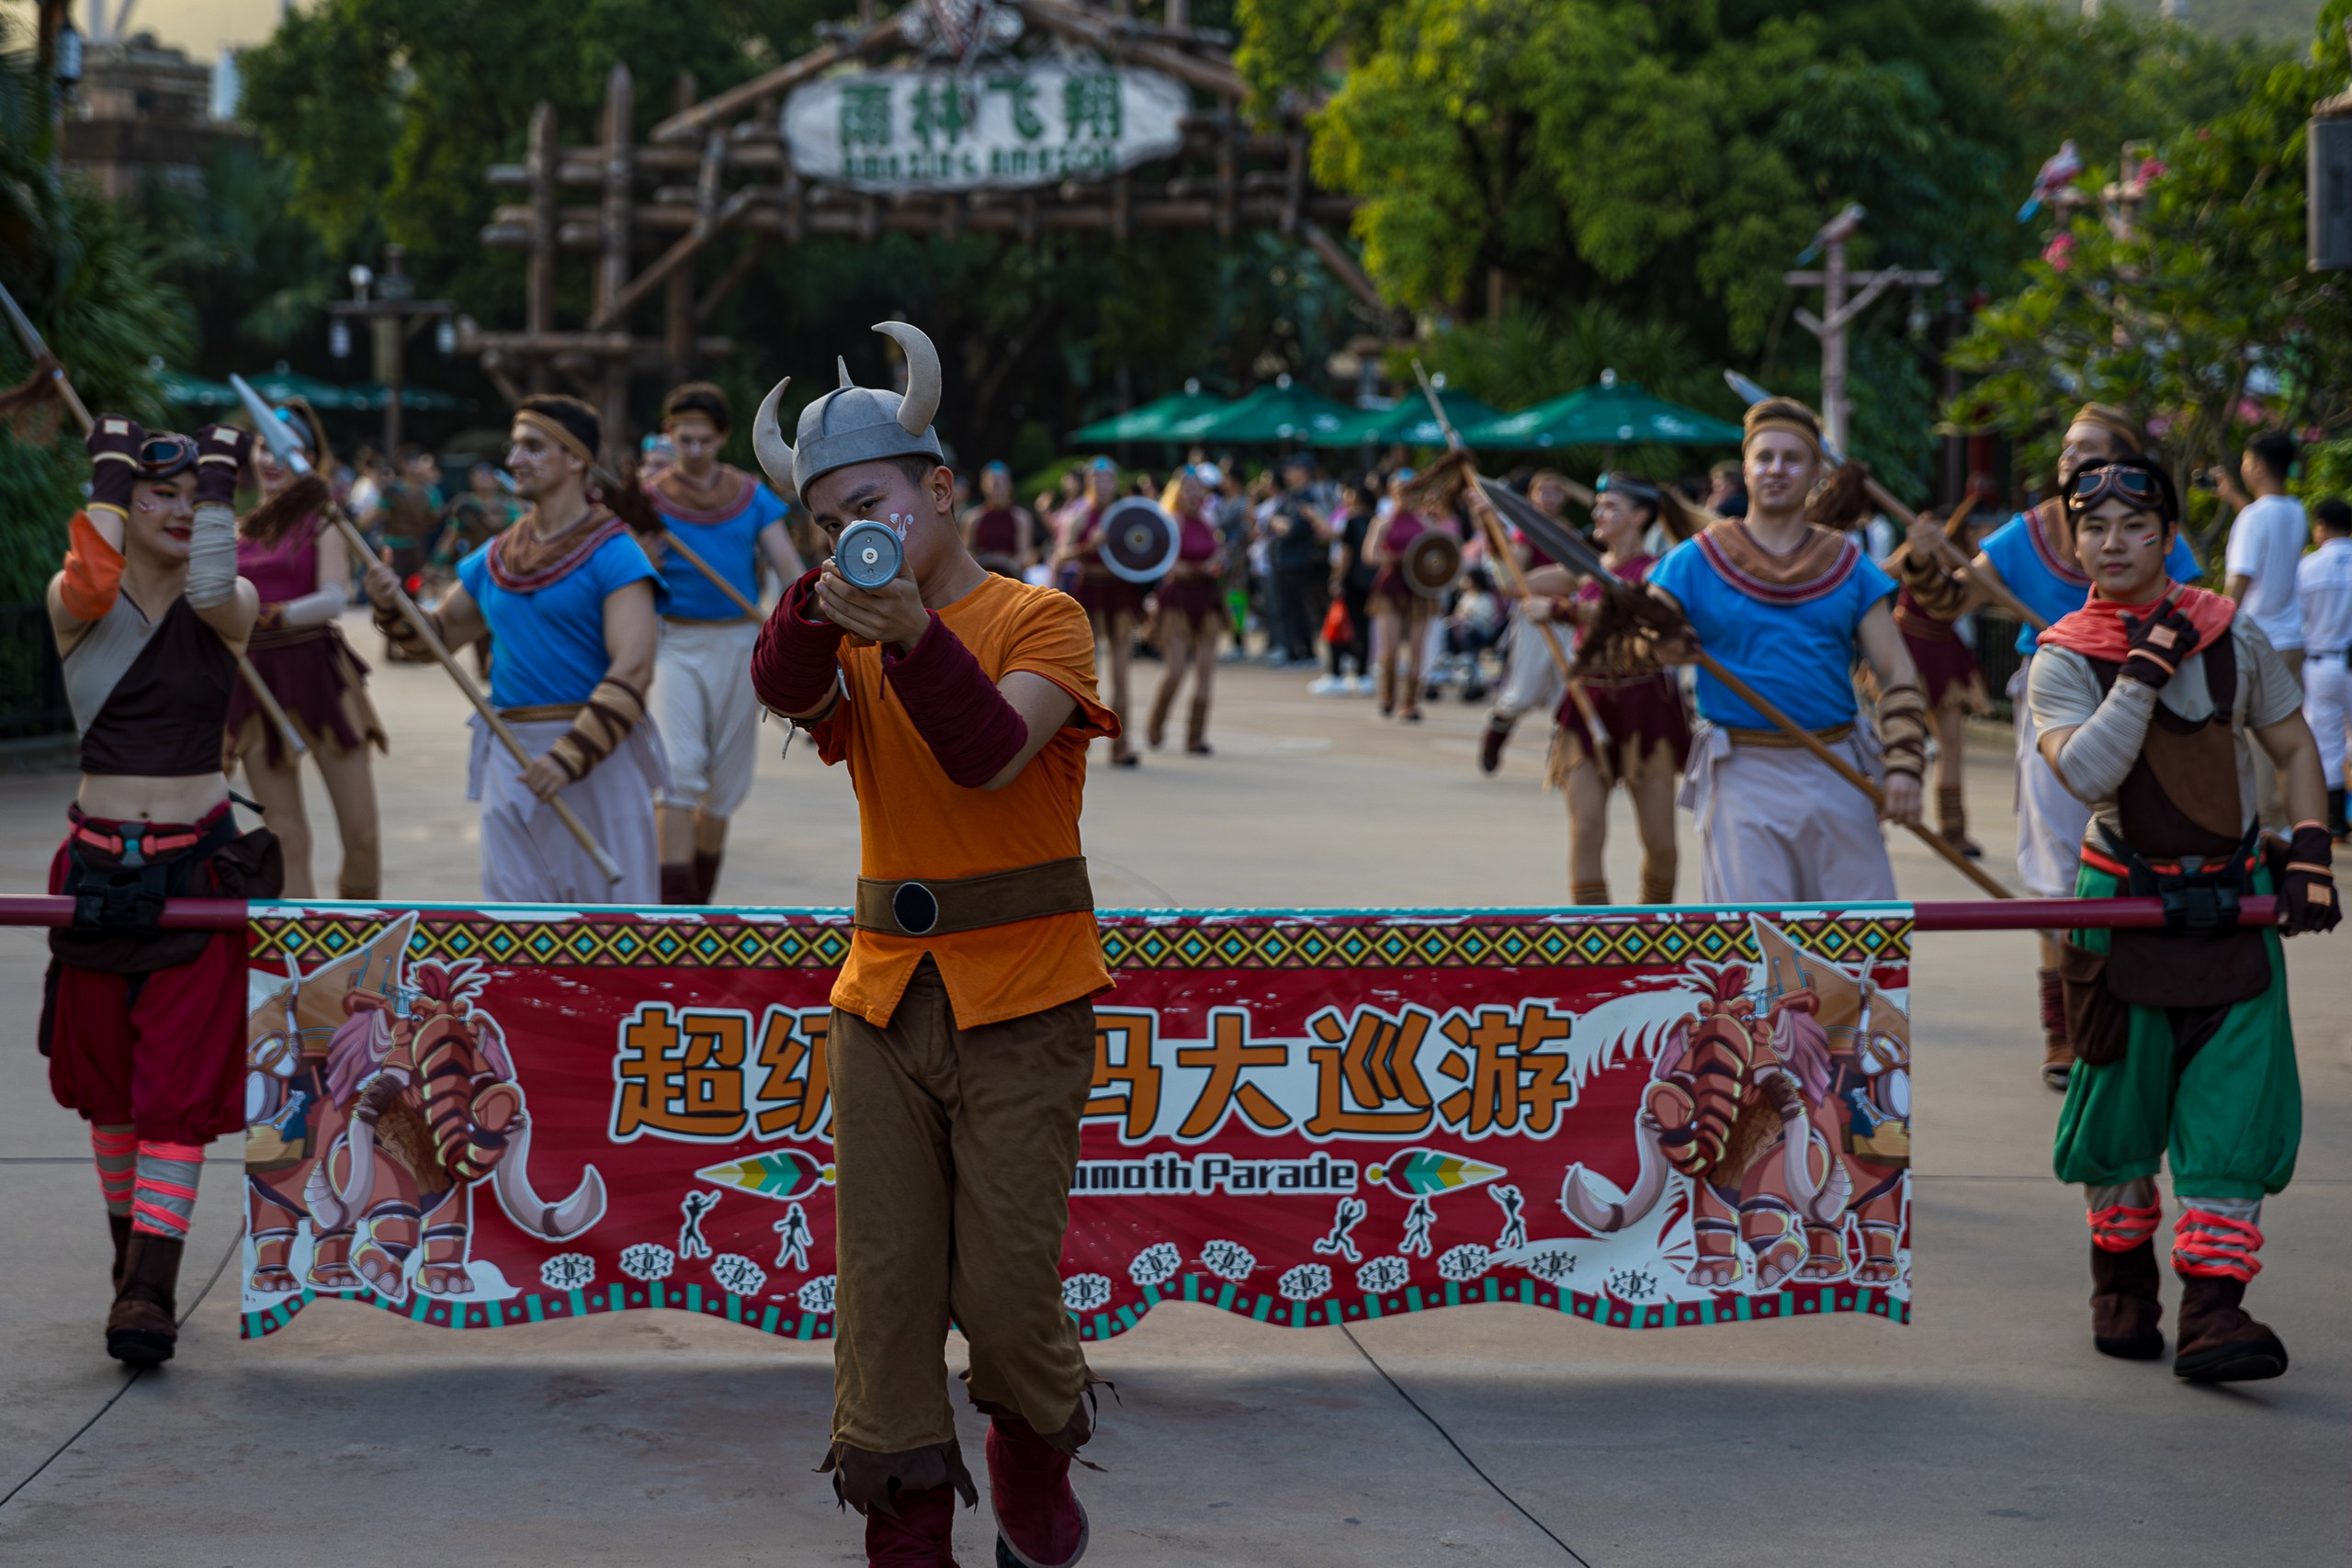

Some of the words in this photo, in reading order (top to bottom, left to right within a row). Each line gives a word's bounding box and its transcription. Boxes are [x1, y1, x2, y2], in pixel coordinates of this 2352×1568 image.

[838, 72, 1123, 145] 雨林飞翔
[1201, 1156, 1355, 1190] Parade
